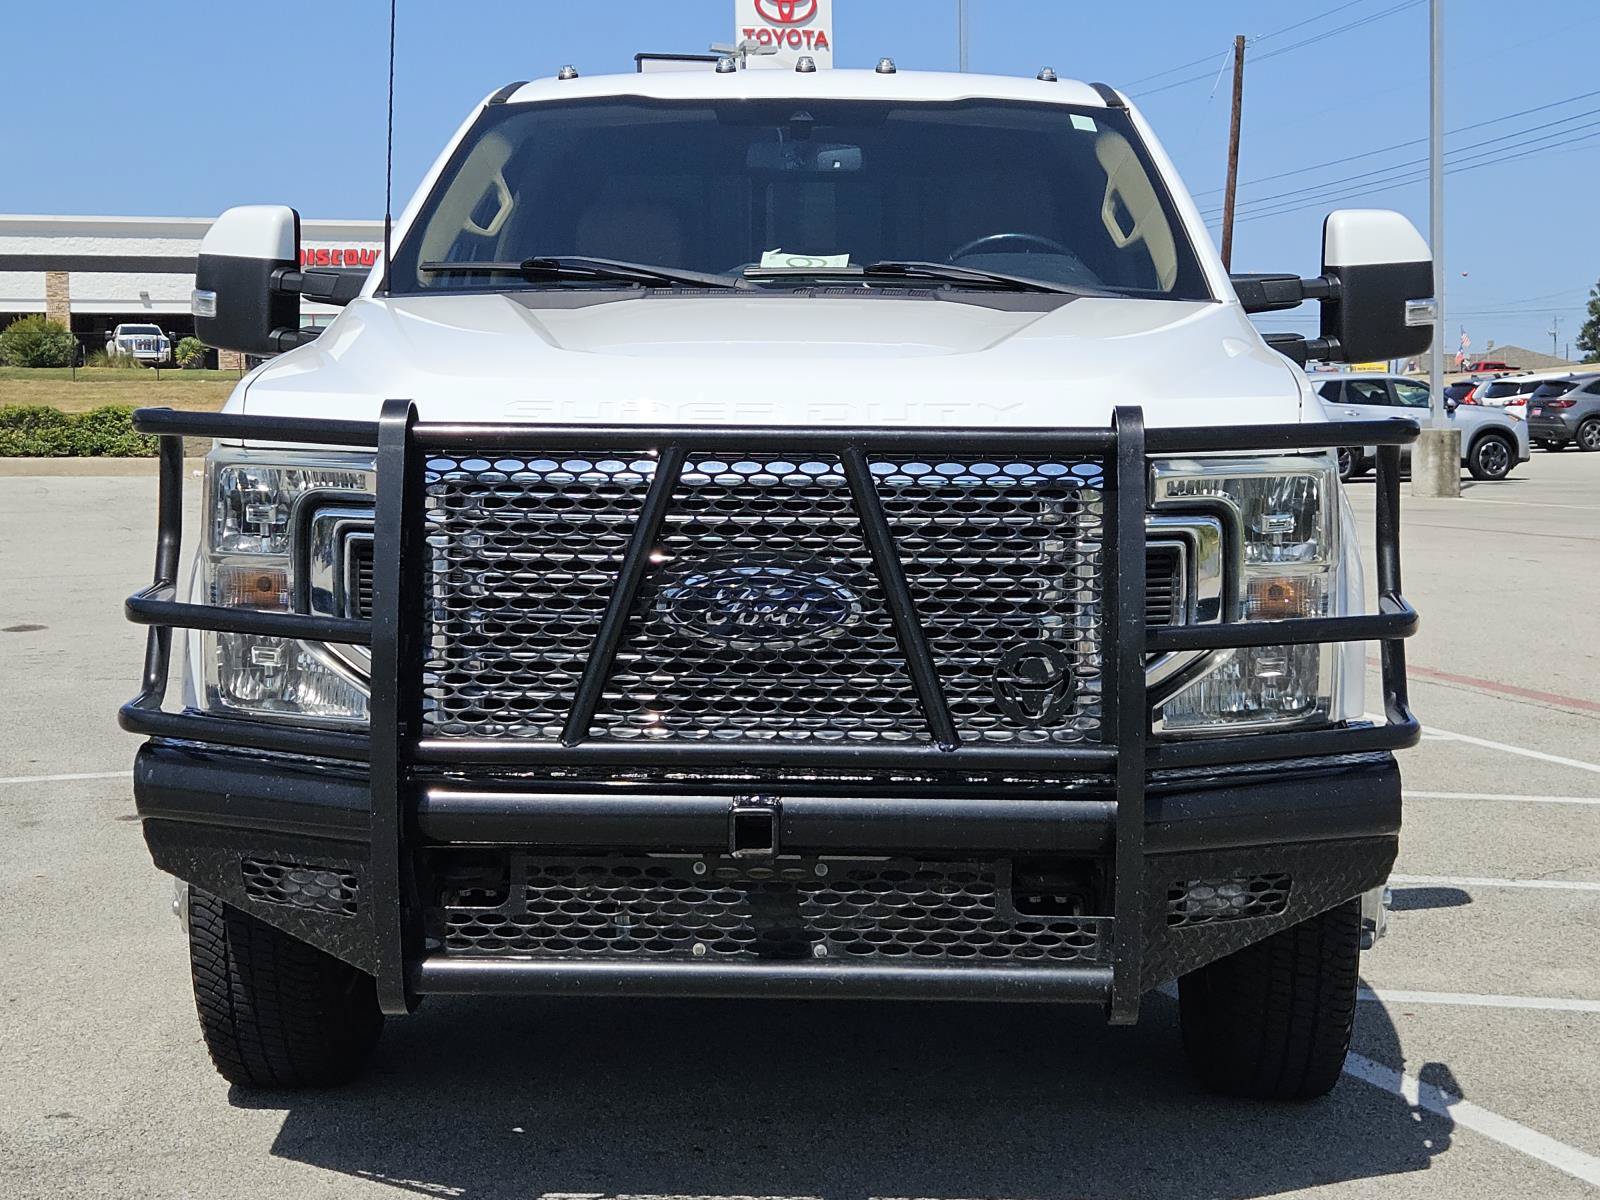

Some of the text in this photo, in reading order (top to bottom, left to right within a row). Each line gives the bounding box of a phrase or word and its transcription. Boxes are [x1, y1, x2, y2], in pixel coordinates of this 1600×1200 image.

[742, 28, 829, 50] TOYOTA
[504, 400, 1025, 422] SUPER DUTY
